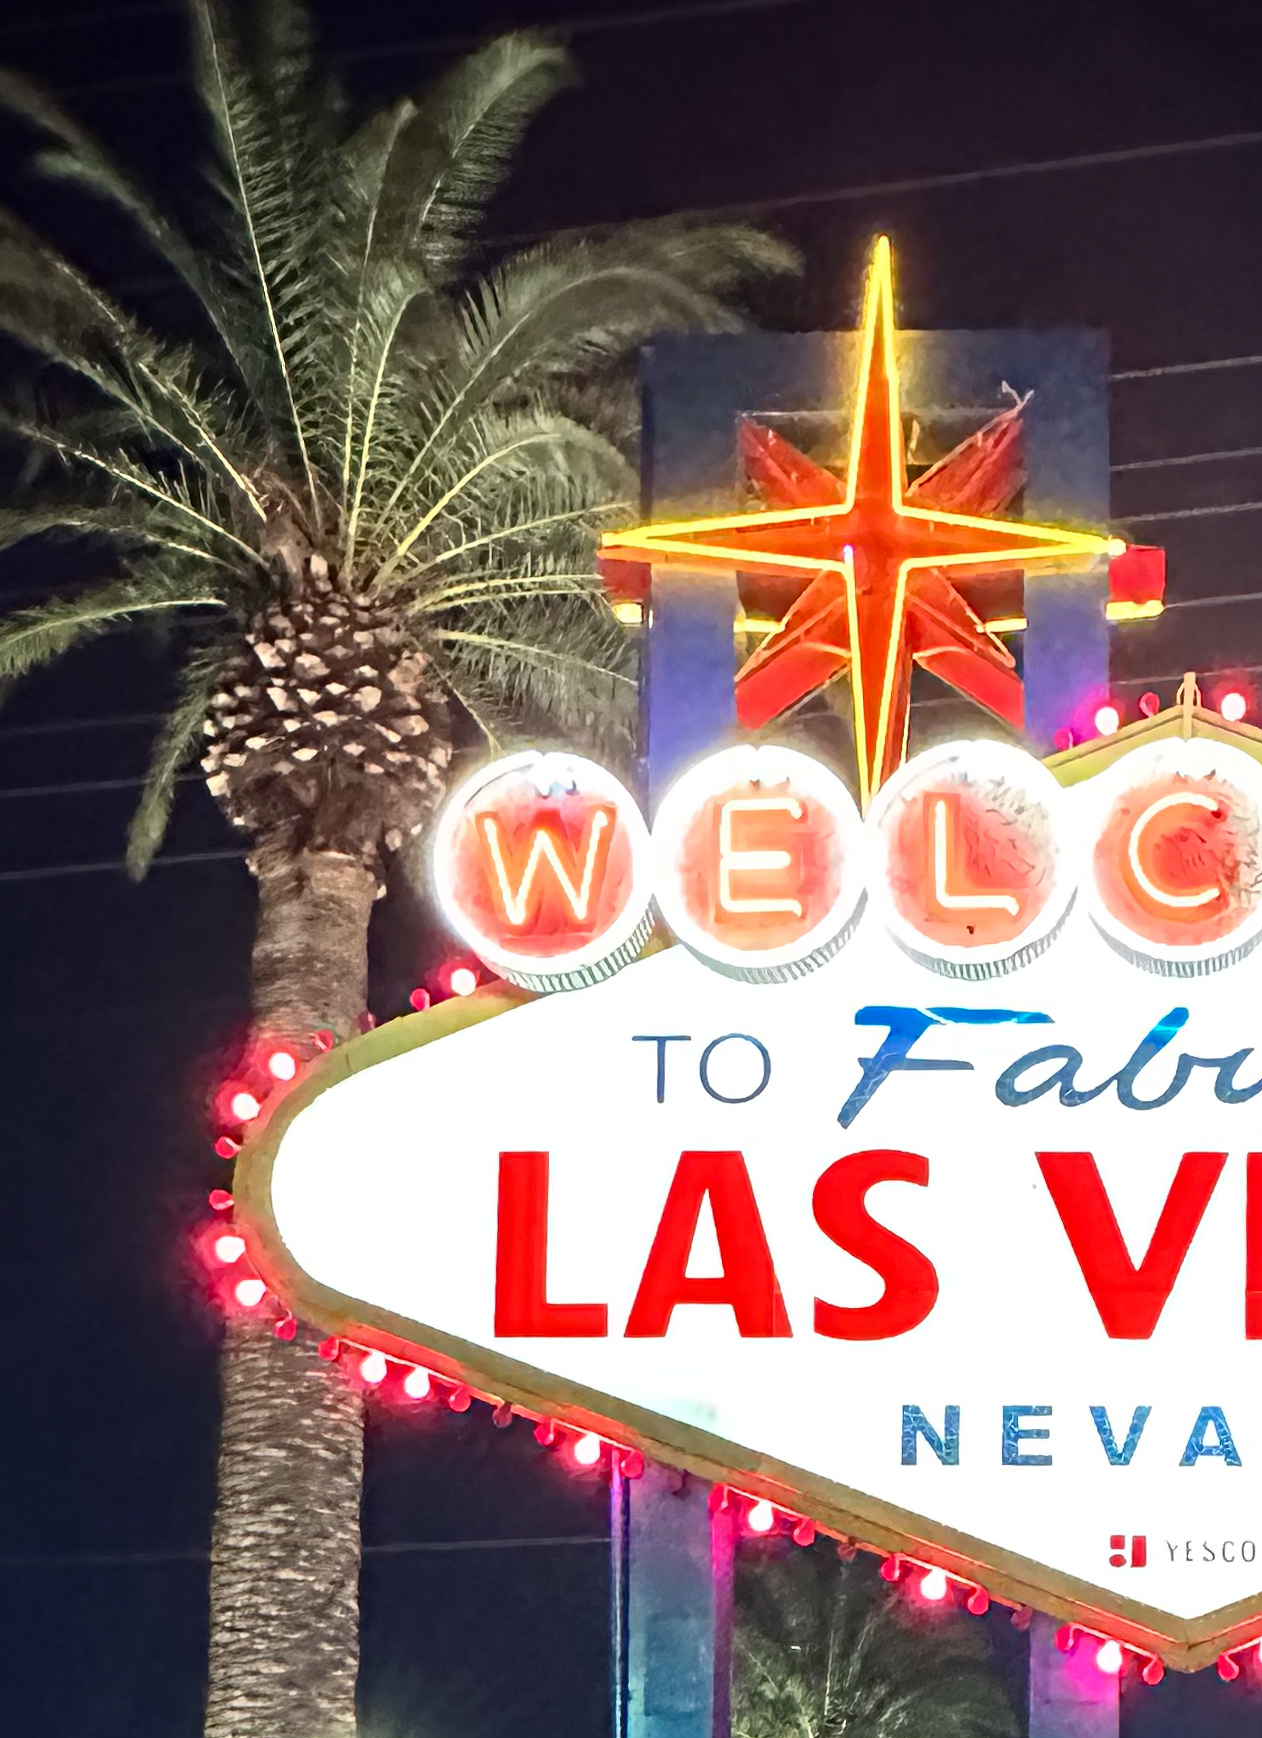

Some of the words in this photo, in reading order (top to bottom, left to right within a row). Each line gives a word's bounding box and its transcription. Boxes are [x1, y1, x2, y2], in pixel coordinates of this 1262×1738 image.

[632, 1033, 771, 1104] TO
[494, 1148, 940, 1341] LAS
[1166, 1540, 1256, 1562] YESCO
